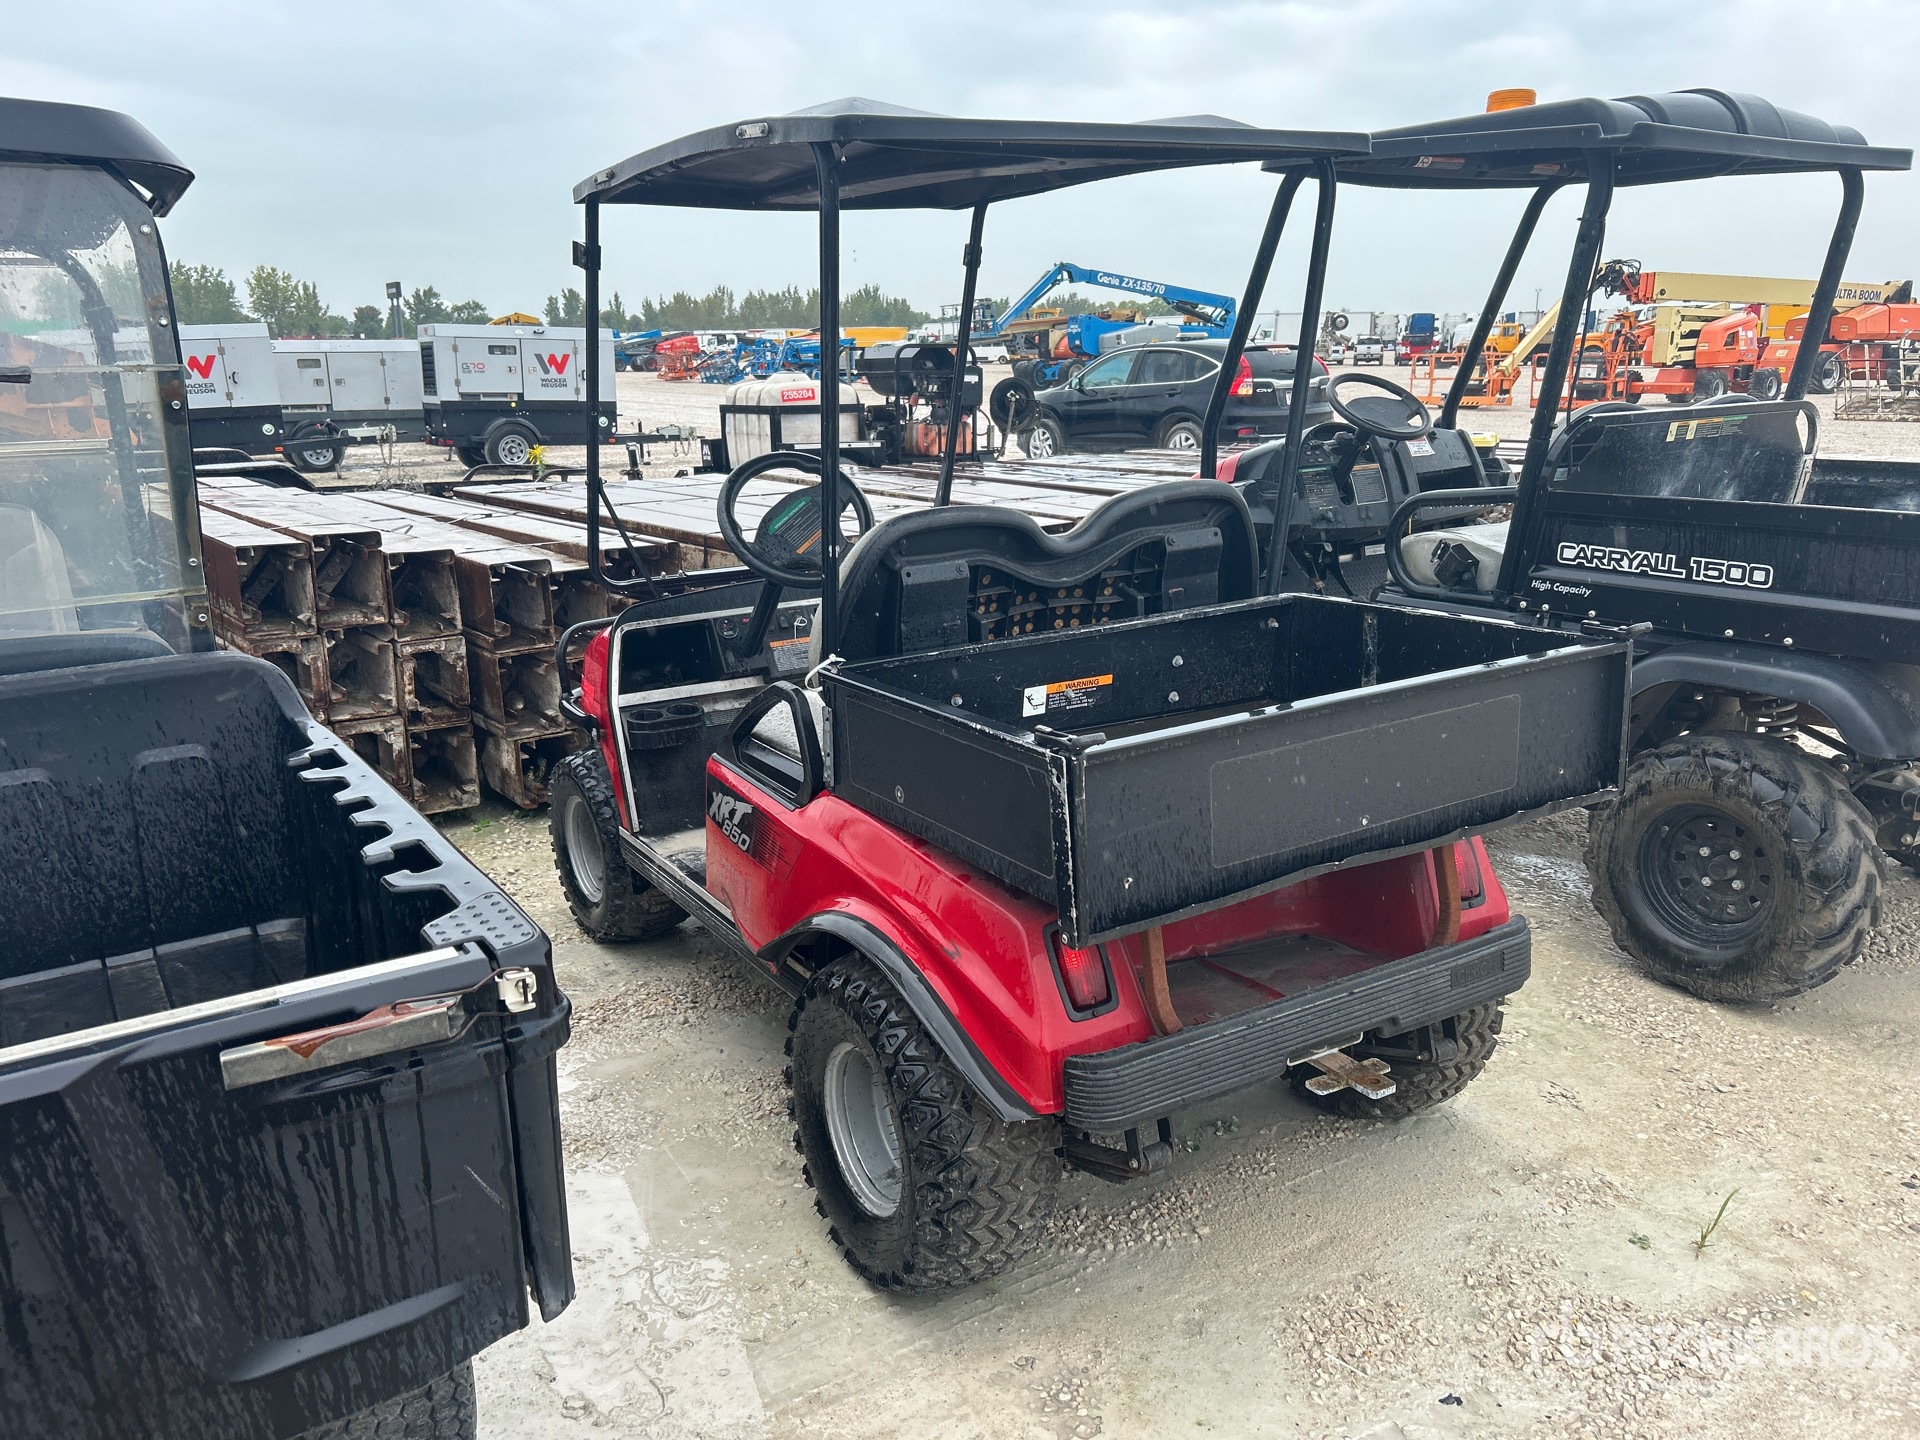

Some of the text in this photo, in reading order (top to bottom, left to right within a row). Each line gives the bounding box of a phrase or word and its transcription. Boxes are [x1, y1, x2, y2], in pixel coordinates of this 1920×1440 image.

[1097, 273, 1166, 295] Genie ZX-135/70
[1858, 290, 1881, 300] BOOM
[461, 362, 485, 370] G70
[783, 390, 814, 400] 255204
[1557, 541, 1773, 589] CARRYALL 1500
[1531, 579, 1592, 598] High Capacity
[1065, 678, 1100, 690] WARNING
[709, 791, 754, 824] XRT
[722, 819, 751, 851] 850
